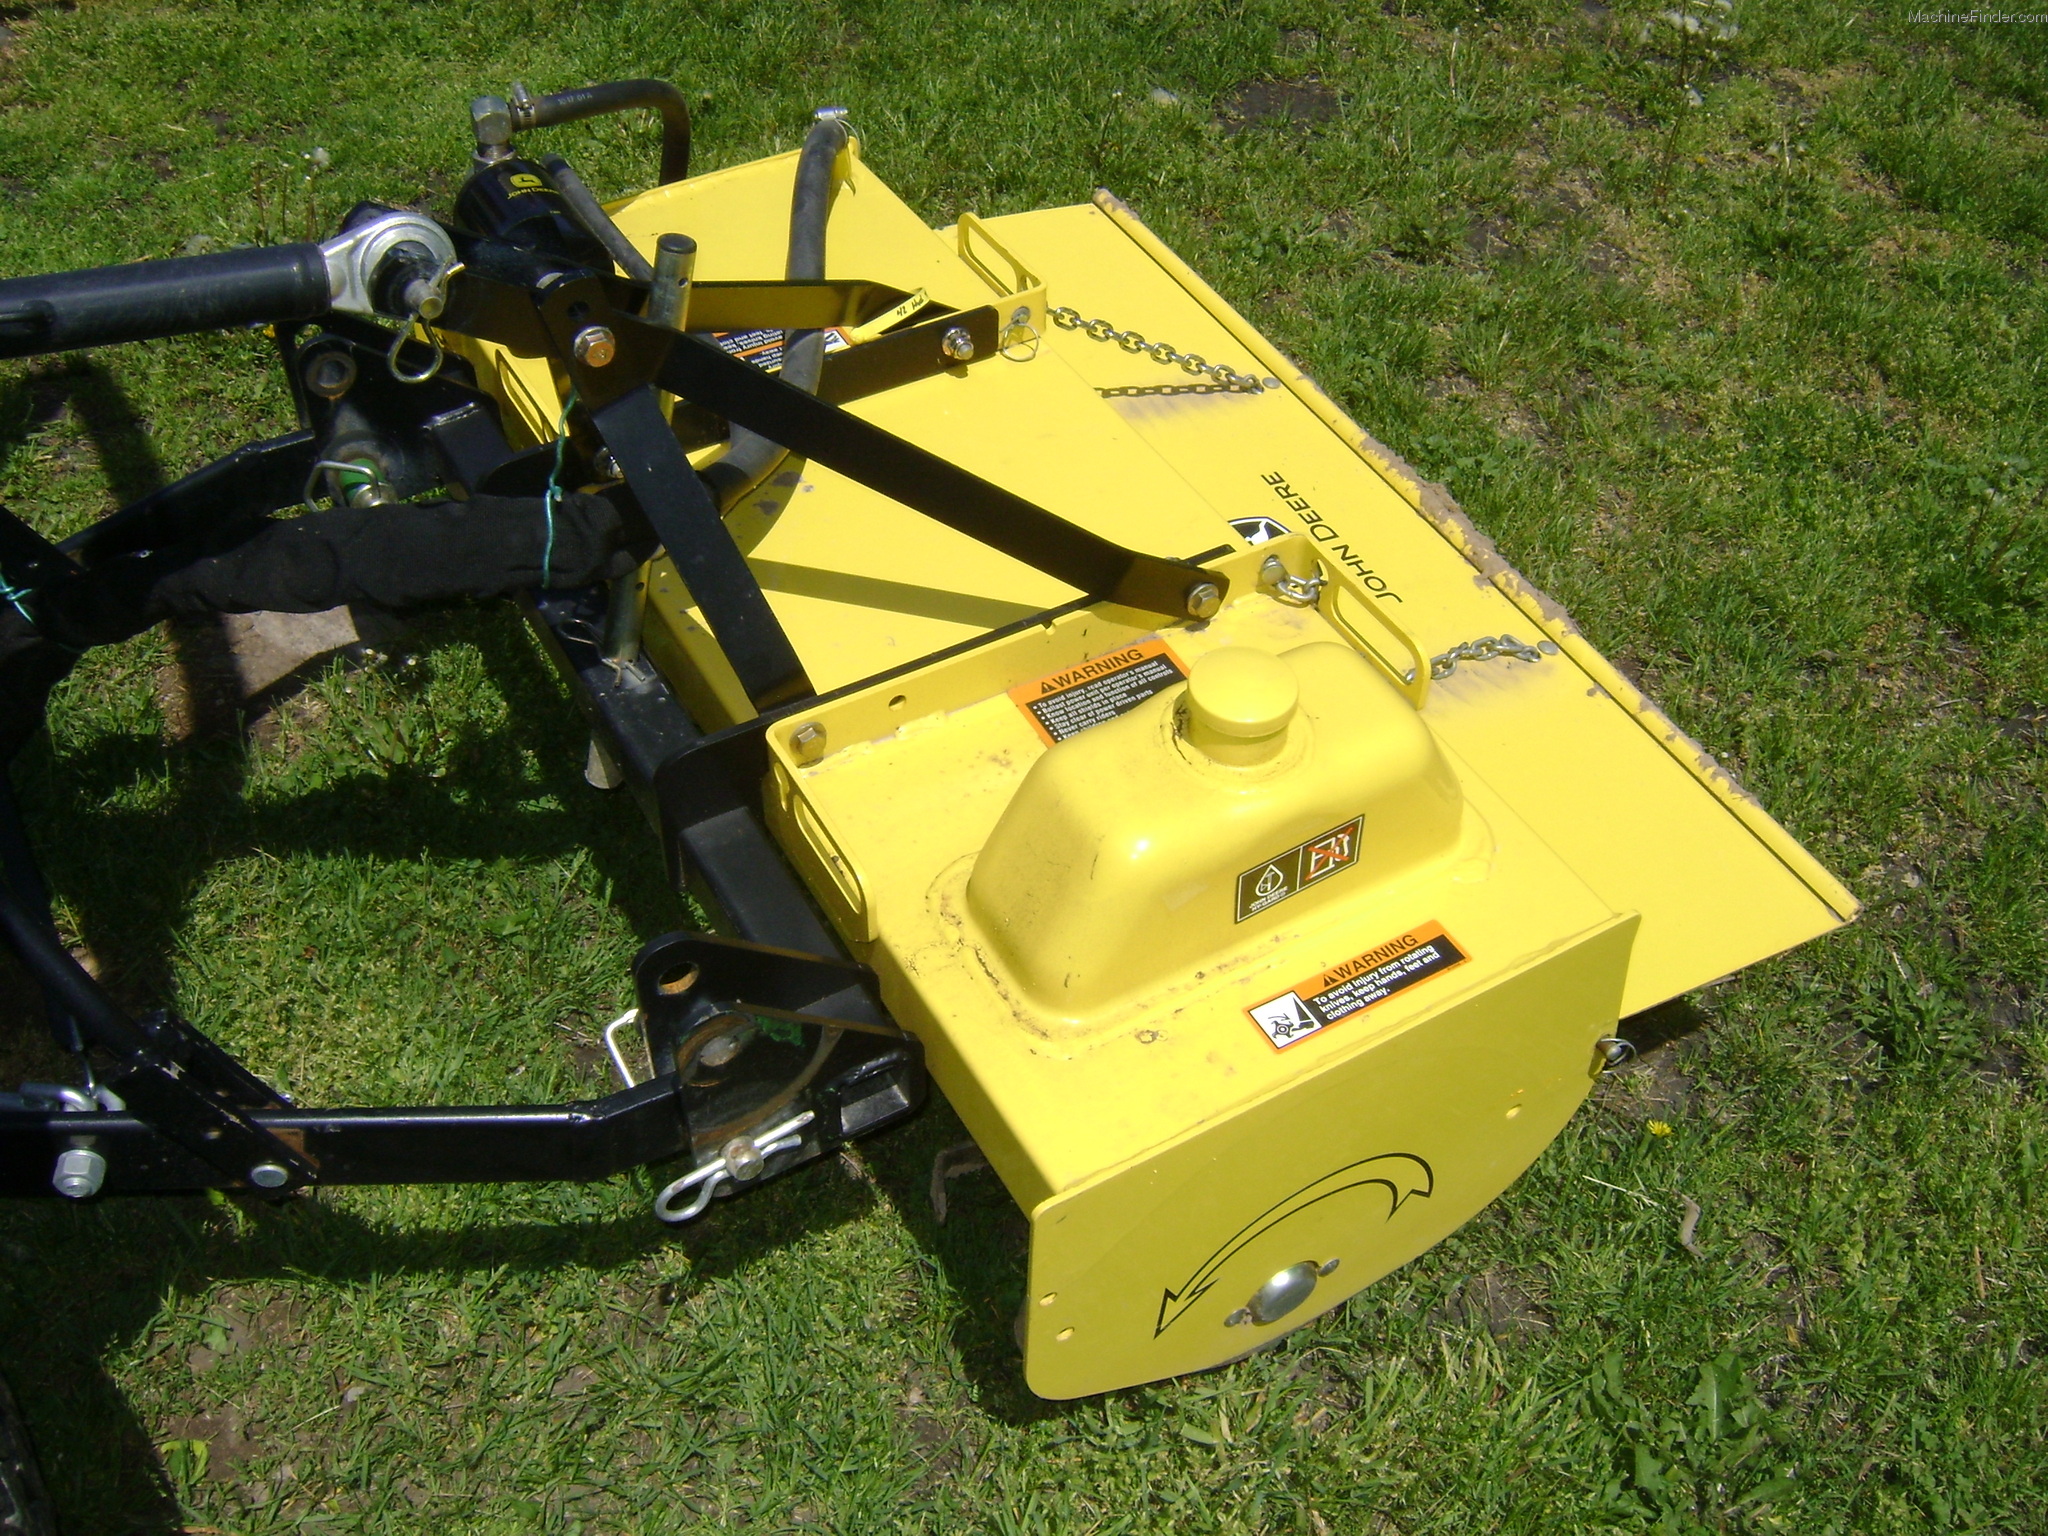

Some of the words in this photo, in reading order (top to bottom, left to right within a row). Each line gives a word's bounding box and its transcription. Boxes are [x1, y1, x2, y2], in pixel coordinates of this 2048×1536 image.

[507, 188, 531, 199] JOHN
[1261, 471, 1340, 542] DEERE
[1331, 544, 1403, 603] JOHN
[1048, 695, 1066, 705] avoid
[1088, 681, 1102, 691] read
[1135, 661, 1158, 673] manual
[1052, 648, 1144, 688] WARNING
[1143, 663, 1167, 676] manual
[1046, 709, 1065, 719] Know
[1066, 699, 1091, 712] location
[1091, 694, 1103, 702] and
[1104, 687, 1130, 699] function
[1138, 677, 1147, 685] all
[1148, 669, 1173, 682] controls
[1050, 715, 1068, 726] Keep
[1079, 703, 1102, 715] shields
[1110, 692, 1128, 703] place
[1055, 720, 1070, 730] Stay
[1071, 714, 1088, 724] clear
[1096, 703, 1116, 715] power
[1117, 695, 1137, 707] driven
[1137, 688, 1153, 701] parts
[1059, 725, 1078, 735] Never
[1079, 718, 1096, 728] carry
[1097, 710, 1116, 721] riders
[1313, 996, 1328, 1005] To
[1328, 982, 1353, 1001] avoid
[1379, 959, 1401, 977] from
[1400, 944, 1435, 966] rotating
[1333, 934, 1418, 979] WARNING
[1319, 997, 1354, 1014] knives,
[1353, 982, 1376, 1000] keep
[1375, 970, 1407, 987] hands,
[1404, 961, 1423, 974] feet
[1422, 951, 1440, 963] and
[1326, 999, 1364, 1021] clothing
[1363, 987, 1391, 1003] away.
